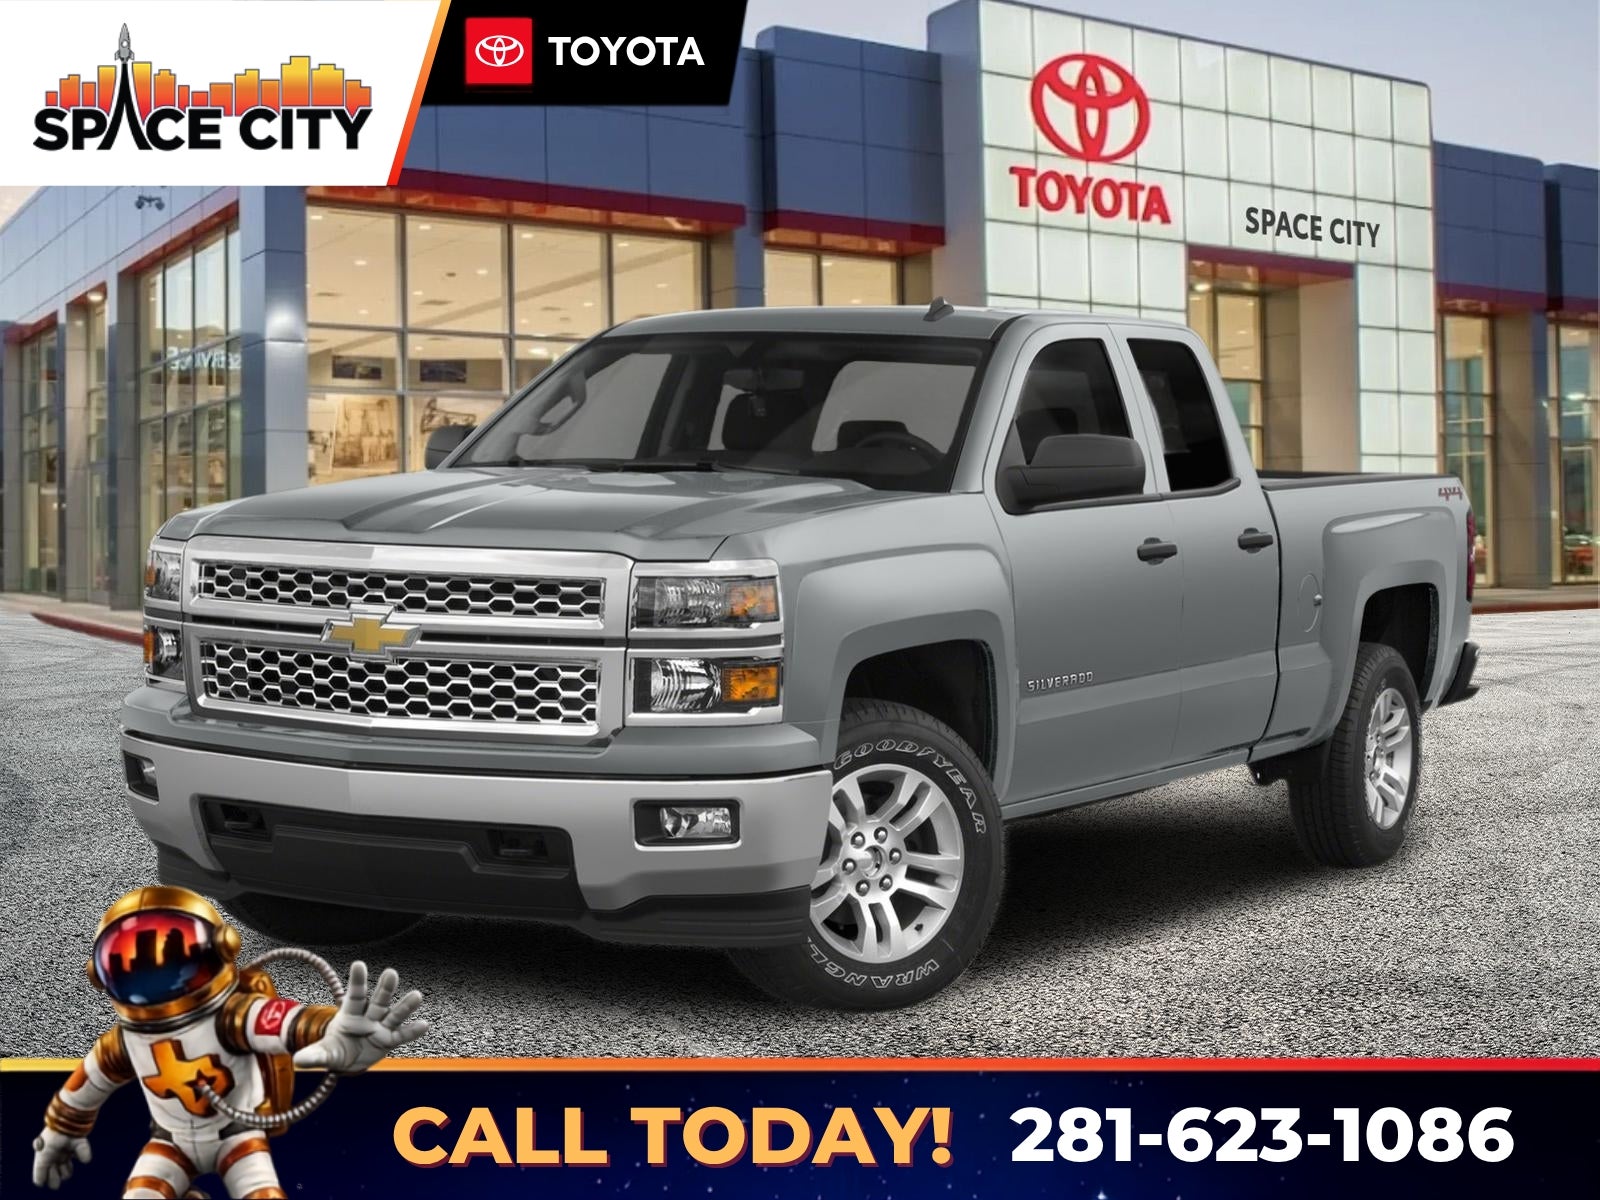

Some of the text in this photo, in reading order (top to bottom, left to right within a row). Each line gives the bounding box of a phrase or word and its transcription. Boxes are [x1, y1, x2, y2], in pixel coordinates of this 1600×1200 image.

[1009, 166, 1171, 225] TOYOTA
[1245, 207, 1381, 248] SPACE CITY
[1027, 671, 1094, 692] SILVERADO
[833, 739, 987, 835] GOODYEAR
[808, 936, 940, 989] WRANGL
